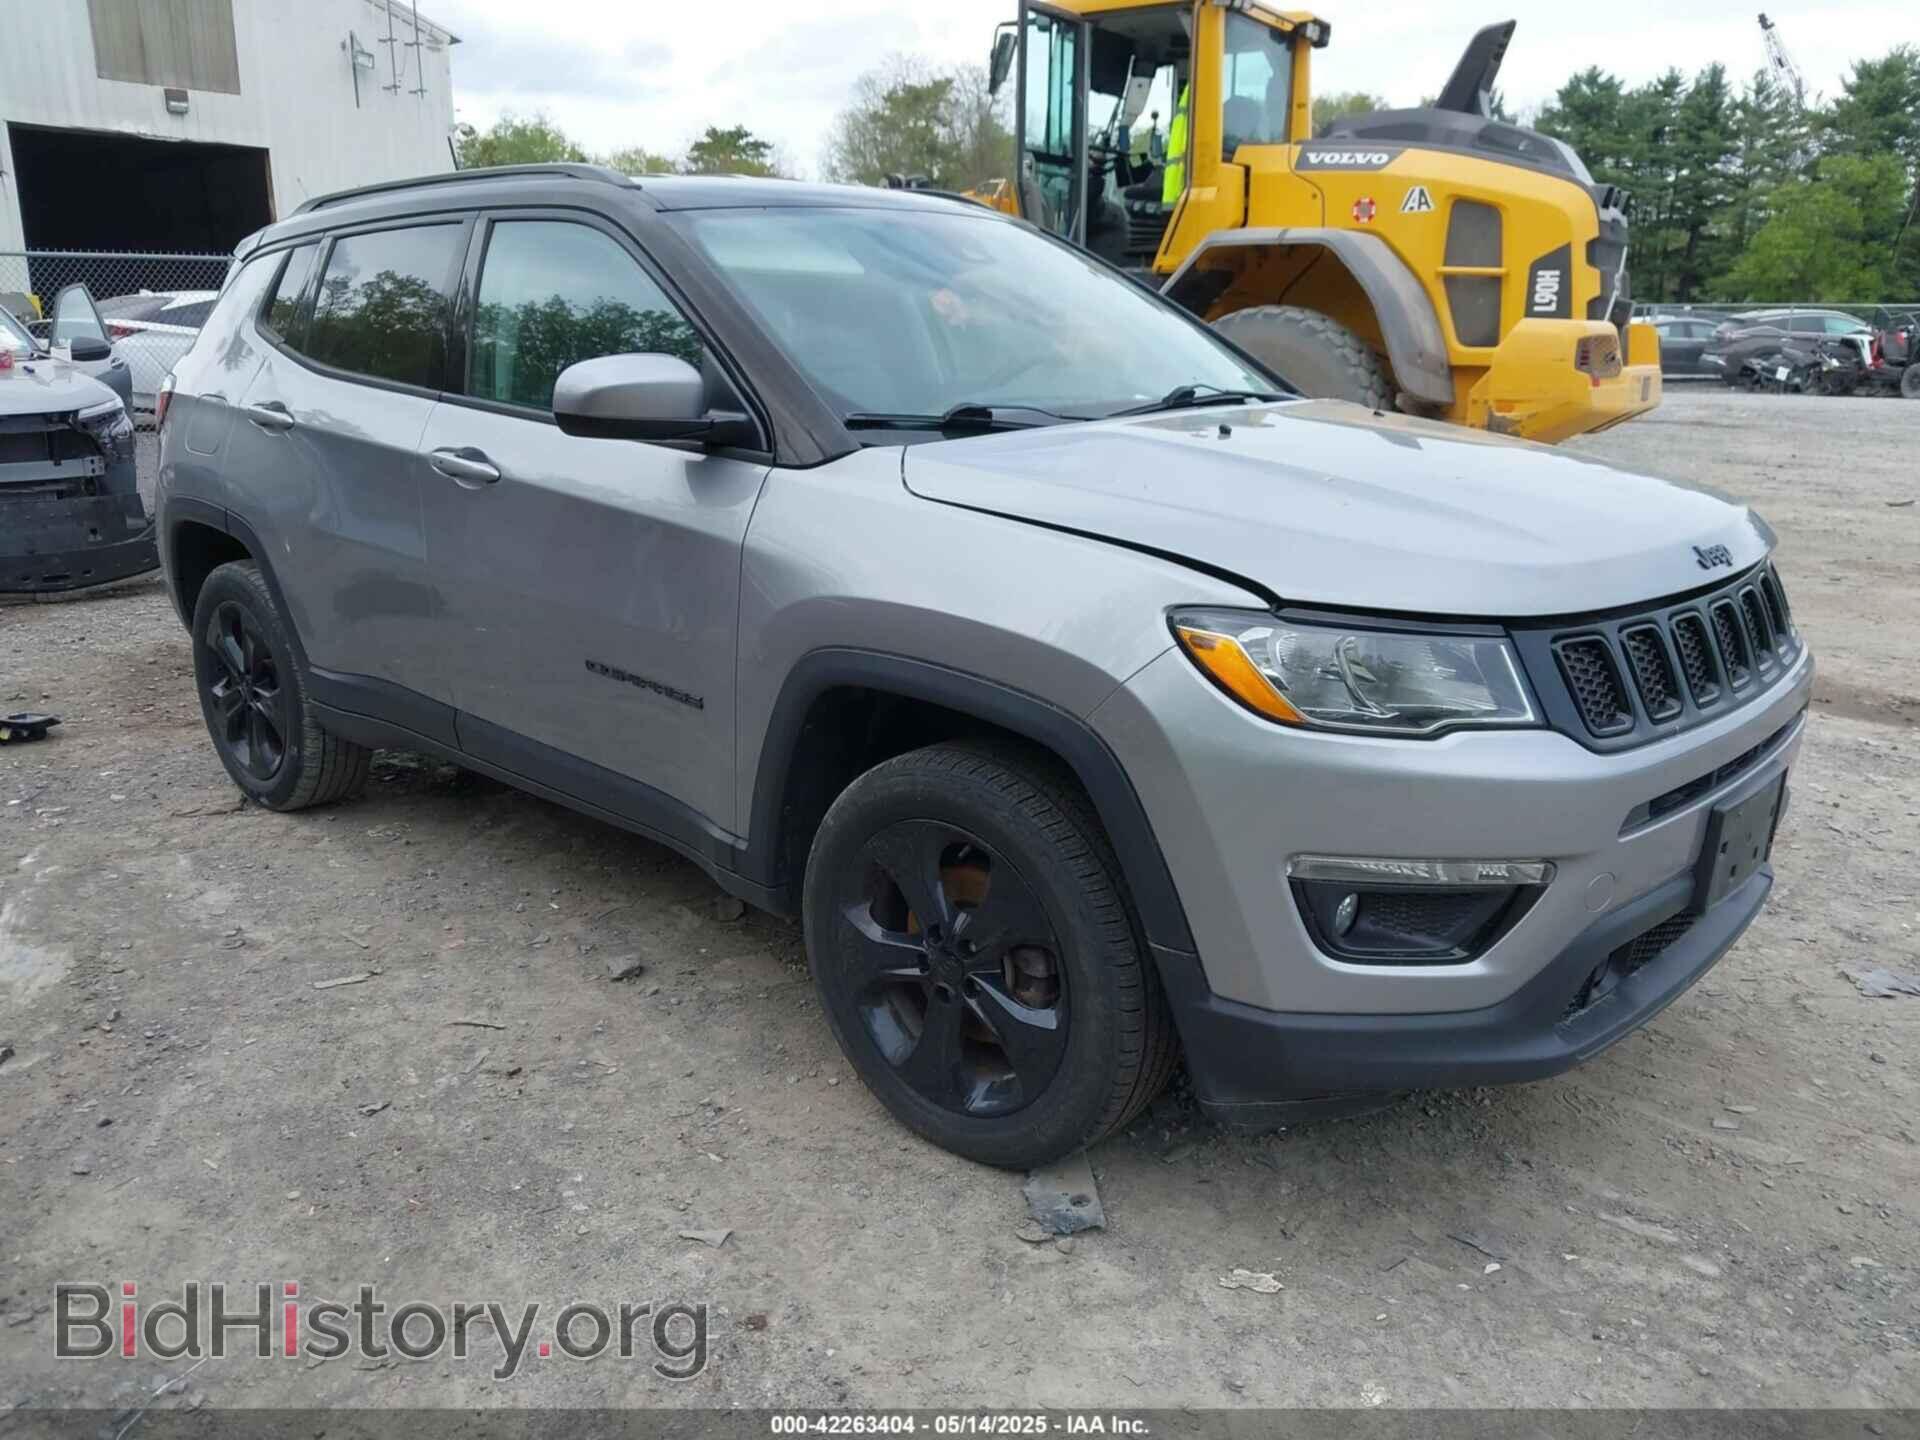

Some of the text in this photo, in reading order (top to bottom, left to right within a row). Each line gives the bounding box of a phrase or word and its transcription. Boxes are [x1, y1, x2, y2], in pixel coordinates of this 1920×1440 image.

[1307, 152, 1389, 164] VOLVO
[1533, 270, 1560, 312] L90H
[1692, 545, 1733, 570] Jeep
